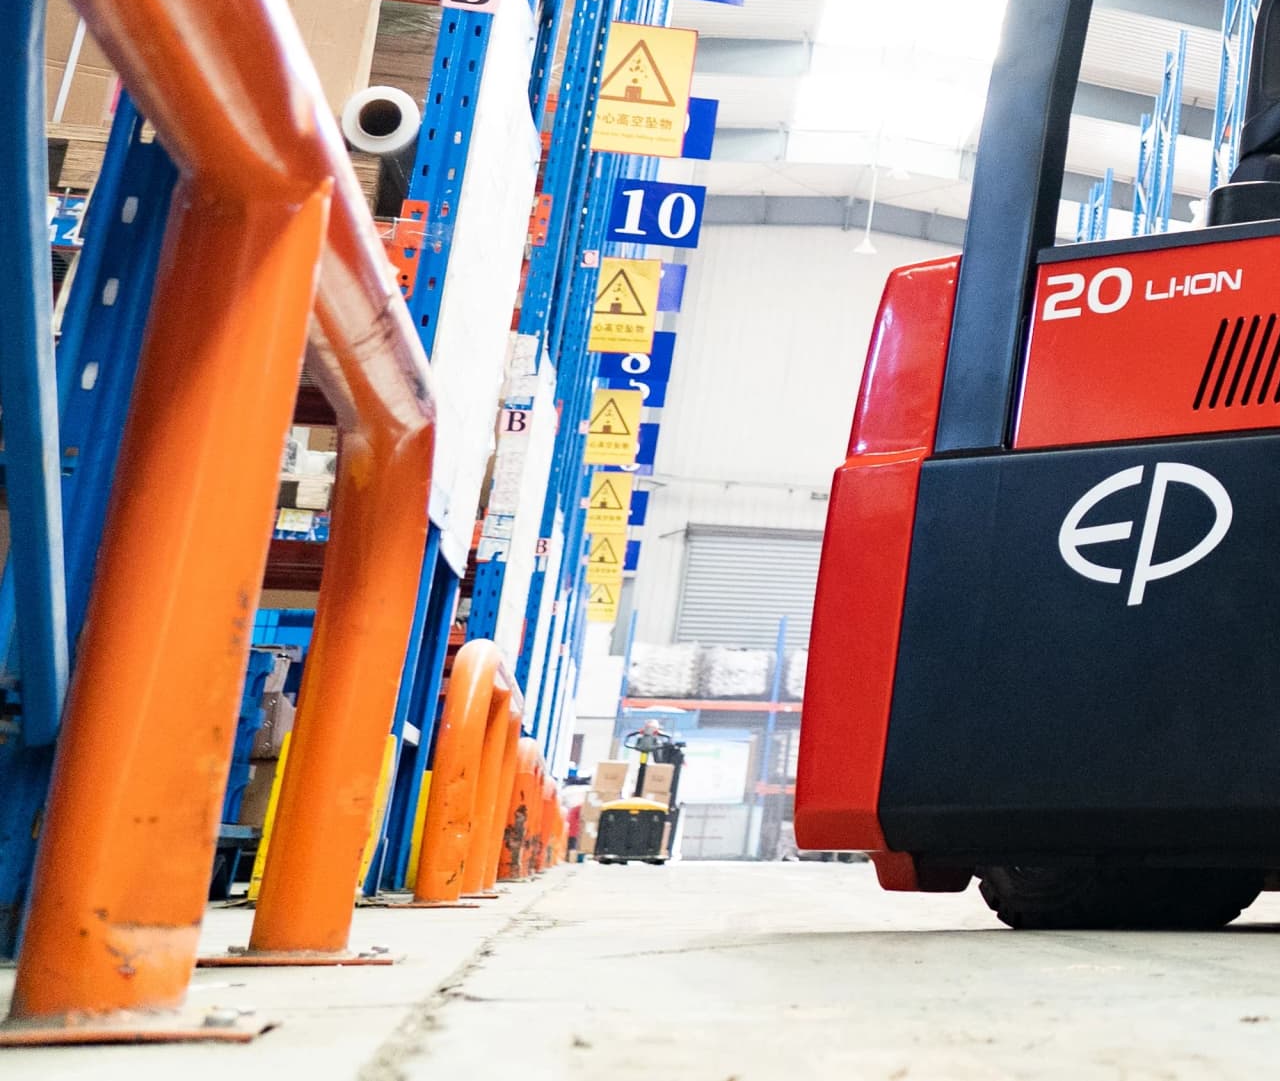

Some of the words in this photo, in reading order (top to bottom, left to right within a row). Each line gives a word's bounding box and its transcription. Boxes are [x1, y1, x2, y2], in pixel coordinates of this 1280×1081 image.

[597, 113, 673, 131] 心高空坠物
[614, 189, 696, 239] 10
[1042, 267, 1133, 321] 20
[505, 410, 527, 432] B
[1058, 461, 1233, 607] EP
